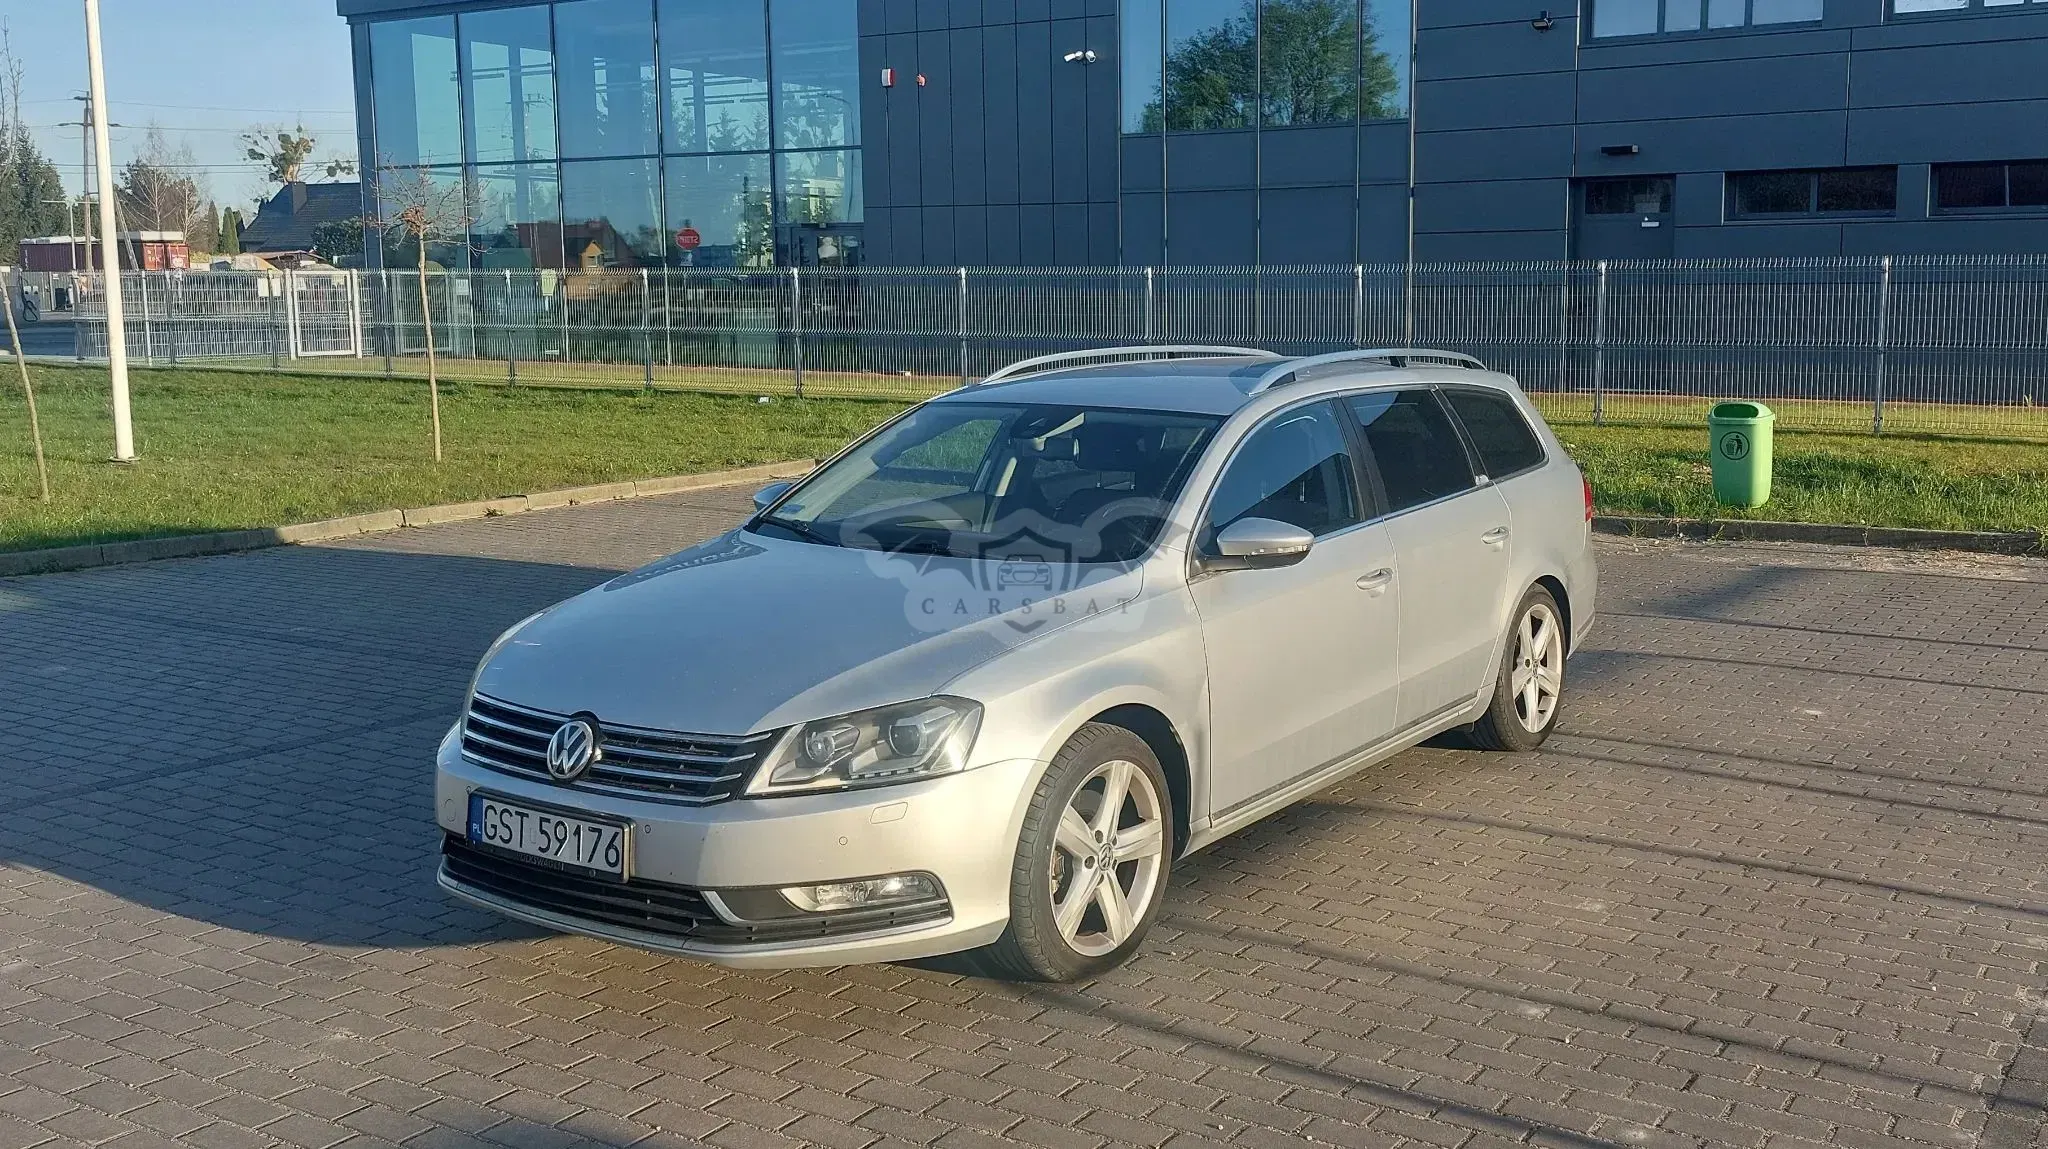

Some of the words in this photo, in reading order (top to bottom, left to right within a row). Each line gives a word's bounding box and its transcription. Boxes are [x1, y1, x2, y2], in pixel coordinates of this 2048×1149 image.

[473, 823, 482, 834] PL
[484, 804, 530, 848] GST
[538, 816, 620, 867] 59176
